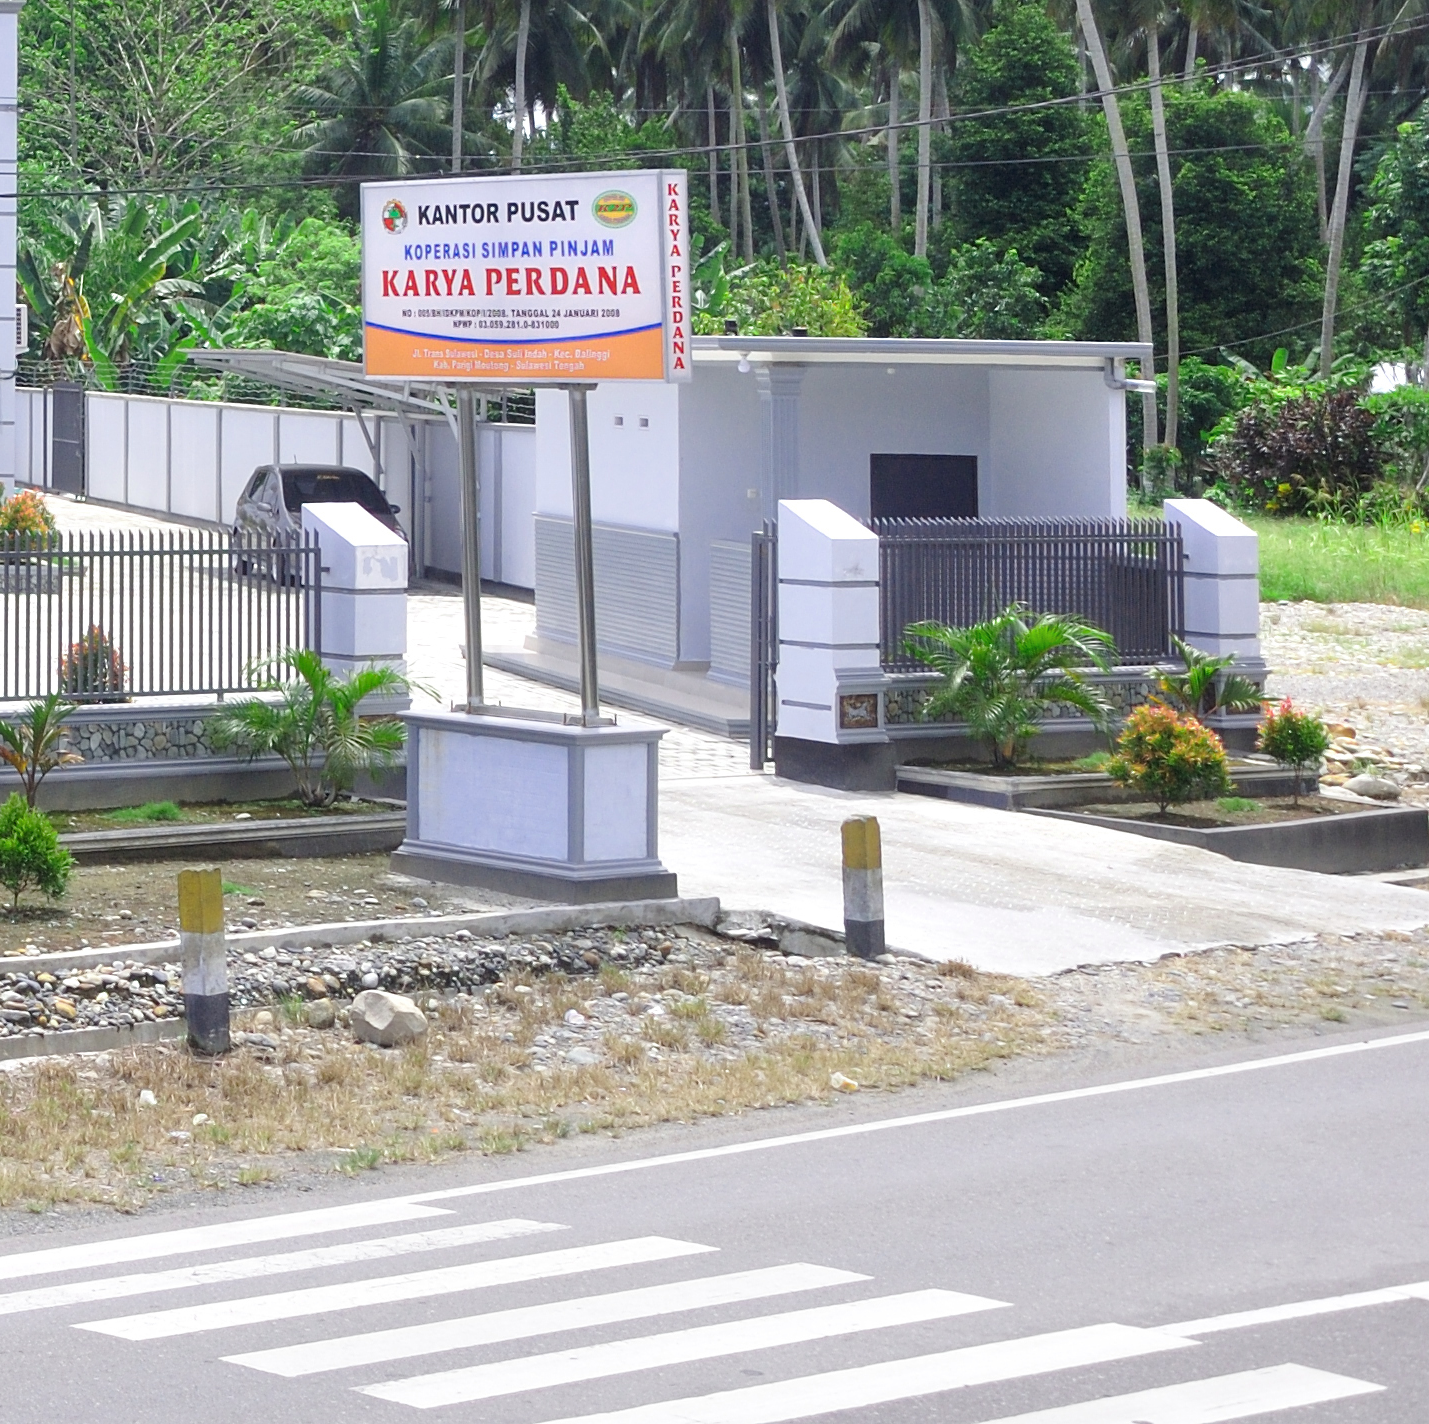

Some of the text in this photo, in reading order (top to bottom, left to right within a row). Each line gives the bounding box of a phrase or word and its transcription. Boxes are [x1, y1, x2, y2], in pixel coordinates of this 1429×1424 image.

[418, 203, 499, 225] KANTOR
[507, 200, 579, 223] PUSAT
[404, 239, 614, 260] KOPERASI SIMPAN PINJAM
[382, 266, 641, 297] KARYA PERDANA
[667, 183, 685, 370] KARYA PERDANA
[511, 309, 549, 317] TANGGAL
[552, 309, 561, 317] 24
[563, 309, 599, 317] JANUARI
[601, 309, 620, 317] 2008
[453, 320, 472, 328] NPWP
[423, 349, 443, 358] Trans
[445, 349, 478, 358] Sulawesi
[484, 349, 504, 358] Desa
[525, 349, 547, 358] Indah
[554, 349, 572, 358] Kec.
[575, 349, 610, 361] Balinggi
[433, 360, 450, 369] Kab.
[452, 360, 473, 371] Parigi
[475, 360, 509, 371] Moutong
[516, 361, 551, 370] Sulawesi
[554, 361, 584, 372] Tengah
